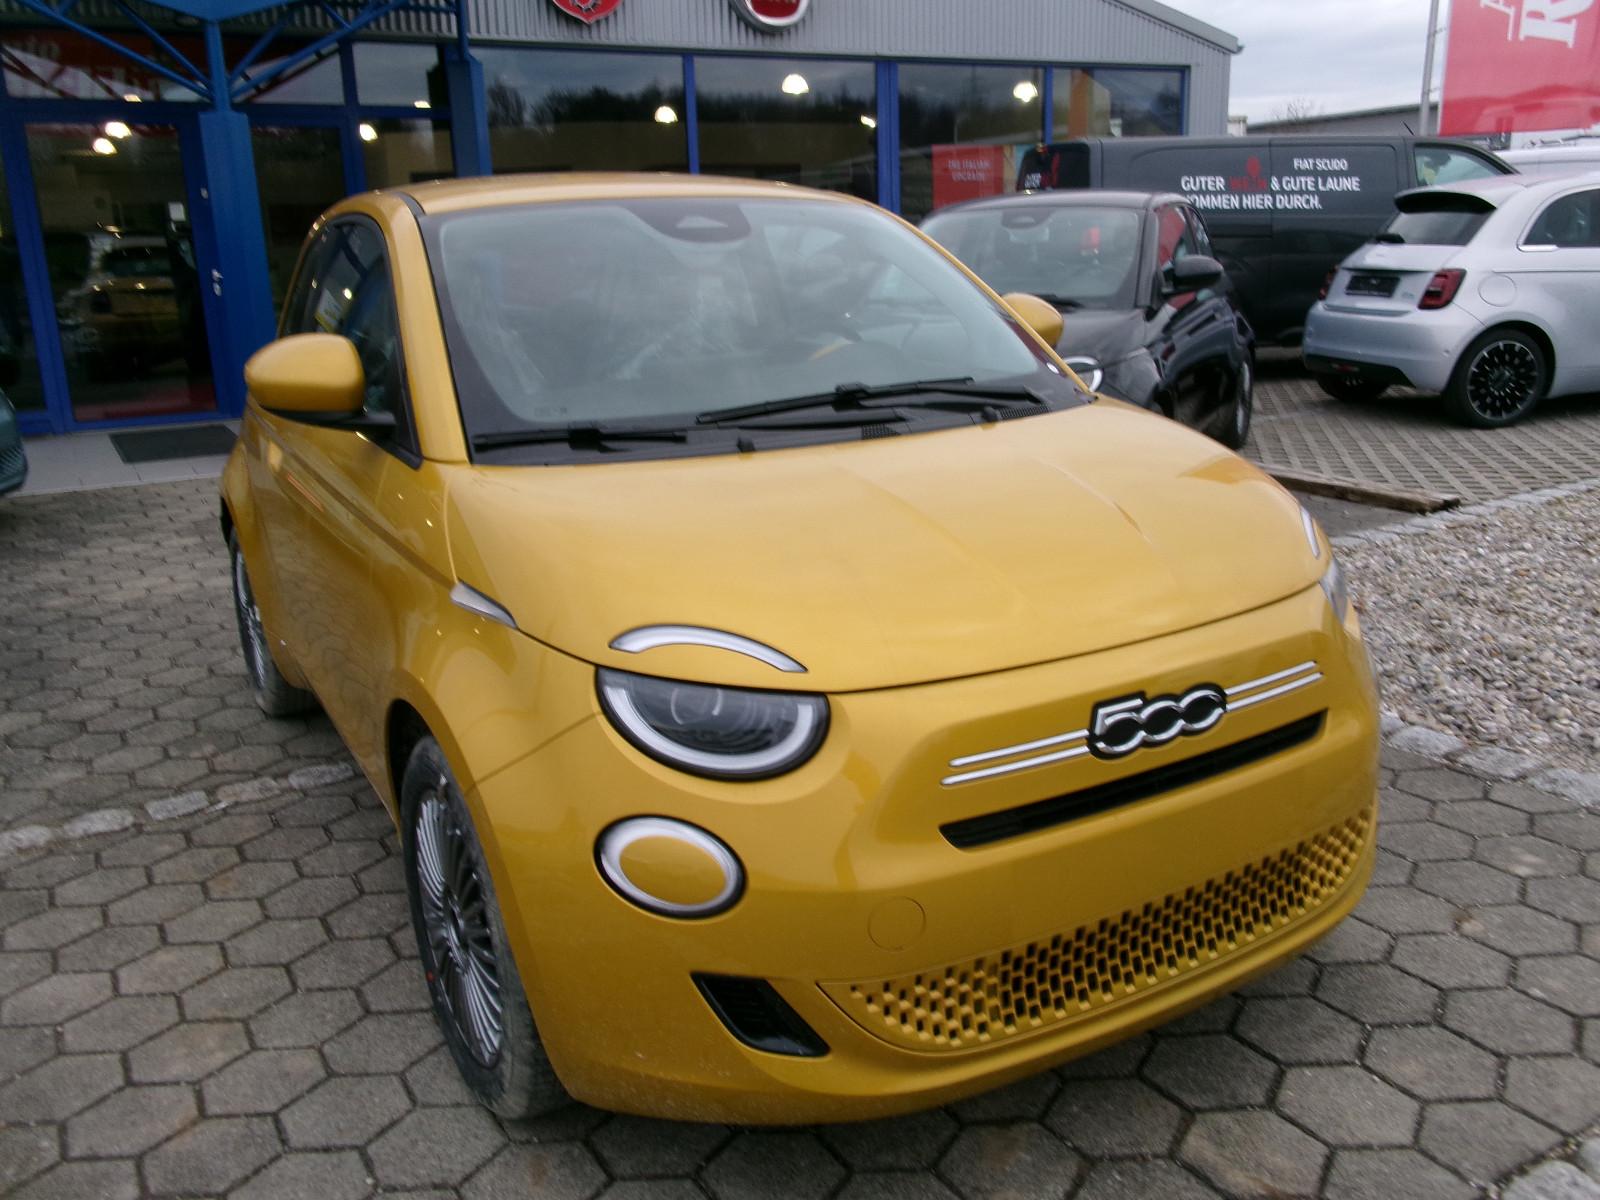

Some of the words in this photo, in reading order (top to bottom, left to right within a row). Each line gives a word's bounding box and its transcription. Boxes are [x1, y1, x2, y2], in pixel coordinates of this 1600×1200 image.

[1293, 158, 1314, 170] FIAT
[1315, 158, 1348, 171] SCUDO
[1180, 175, 1225, 191] GUTER
[1270, 175, 1280, 191] &
[1282, 175, 1315, 191] GUTE
[1317, 175, 1360, 191] LAUNE
[1242, 193, 1273, 209] HIER
[1275, 193, 1322, 210] DURCH.
[1090, 686, 1226, 757] 500
